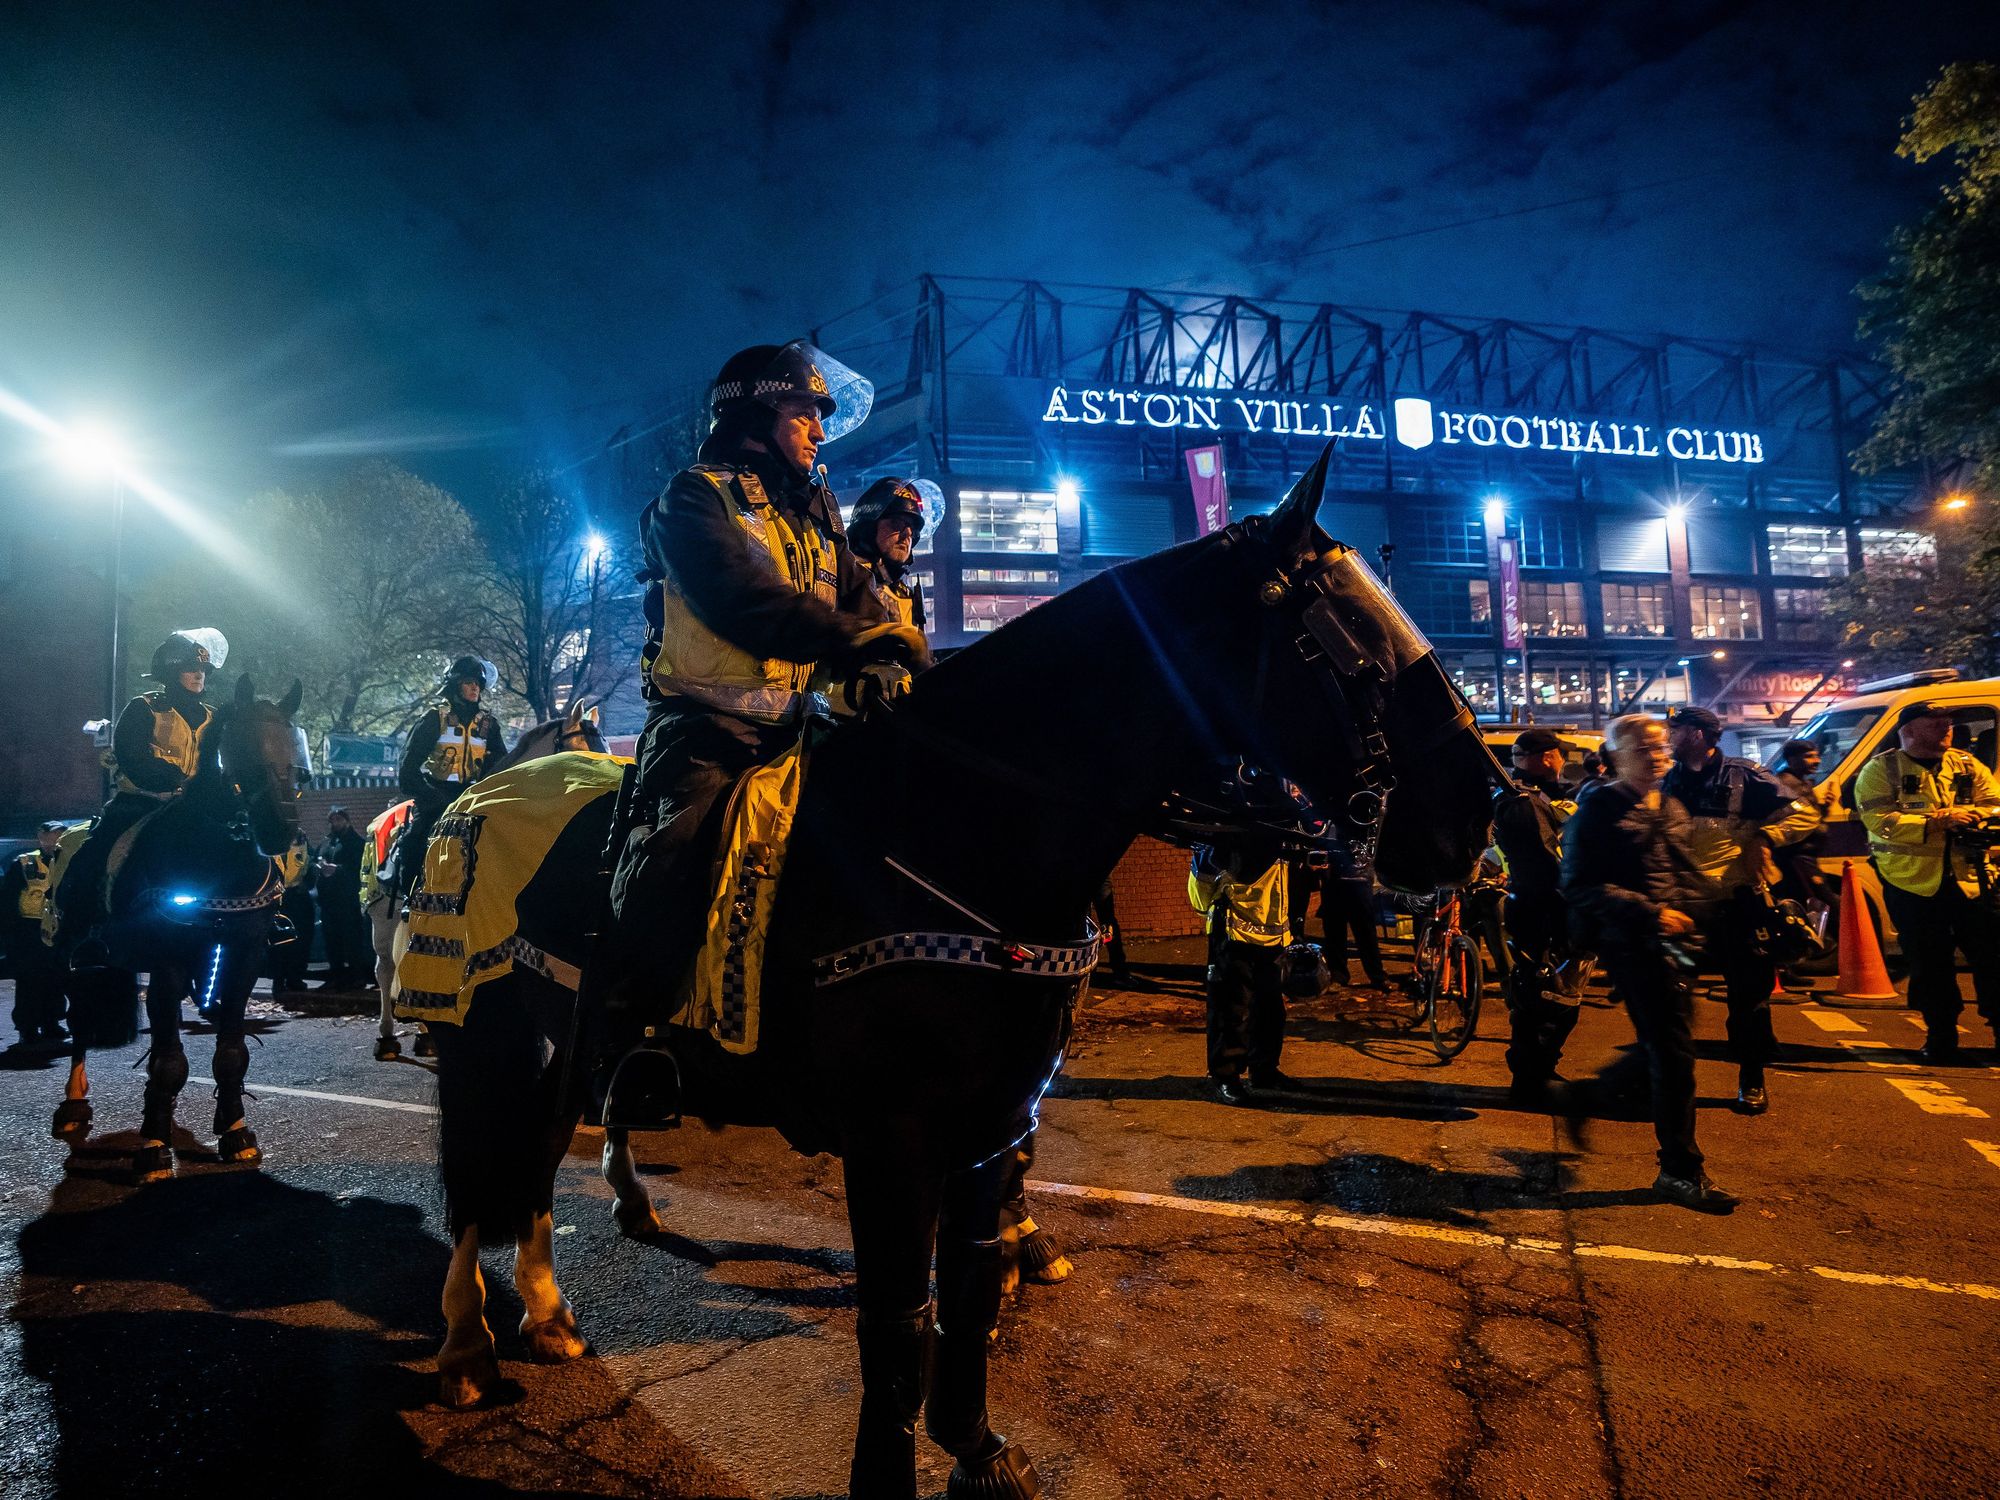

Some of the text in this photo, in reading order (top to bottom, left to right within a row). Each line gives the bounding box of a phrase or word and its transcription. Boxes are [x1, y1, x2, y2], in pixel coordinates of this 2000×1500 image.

[1043, 386, 1764, 463] ASTON VILLA FOOTBALL CLUB
[1778, 672, 1826, 693] Road
